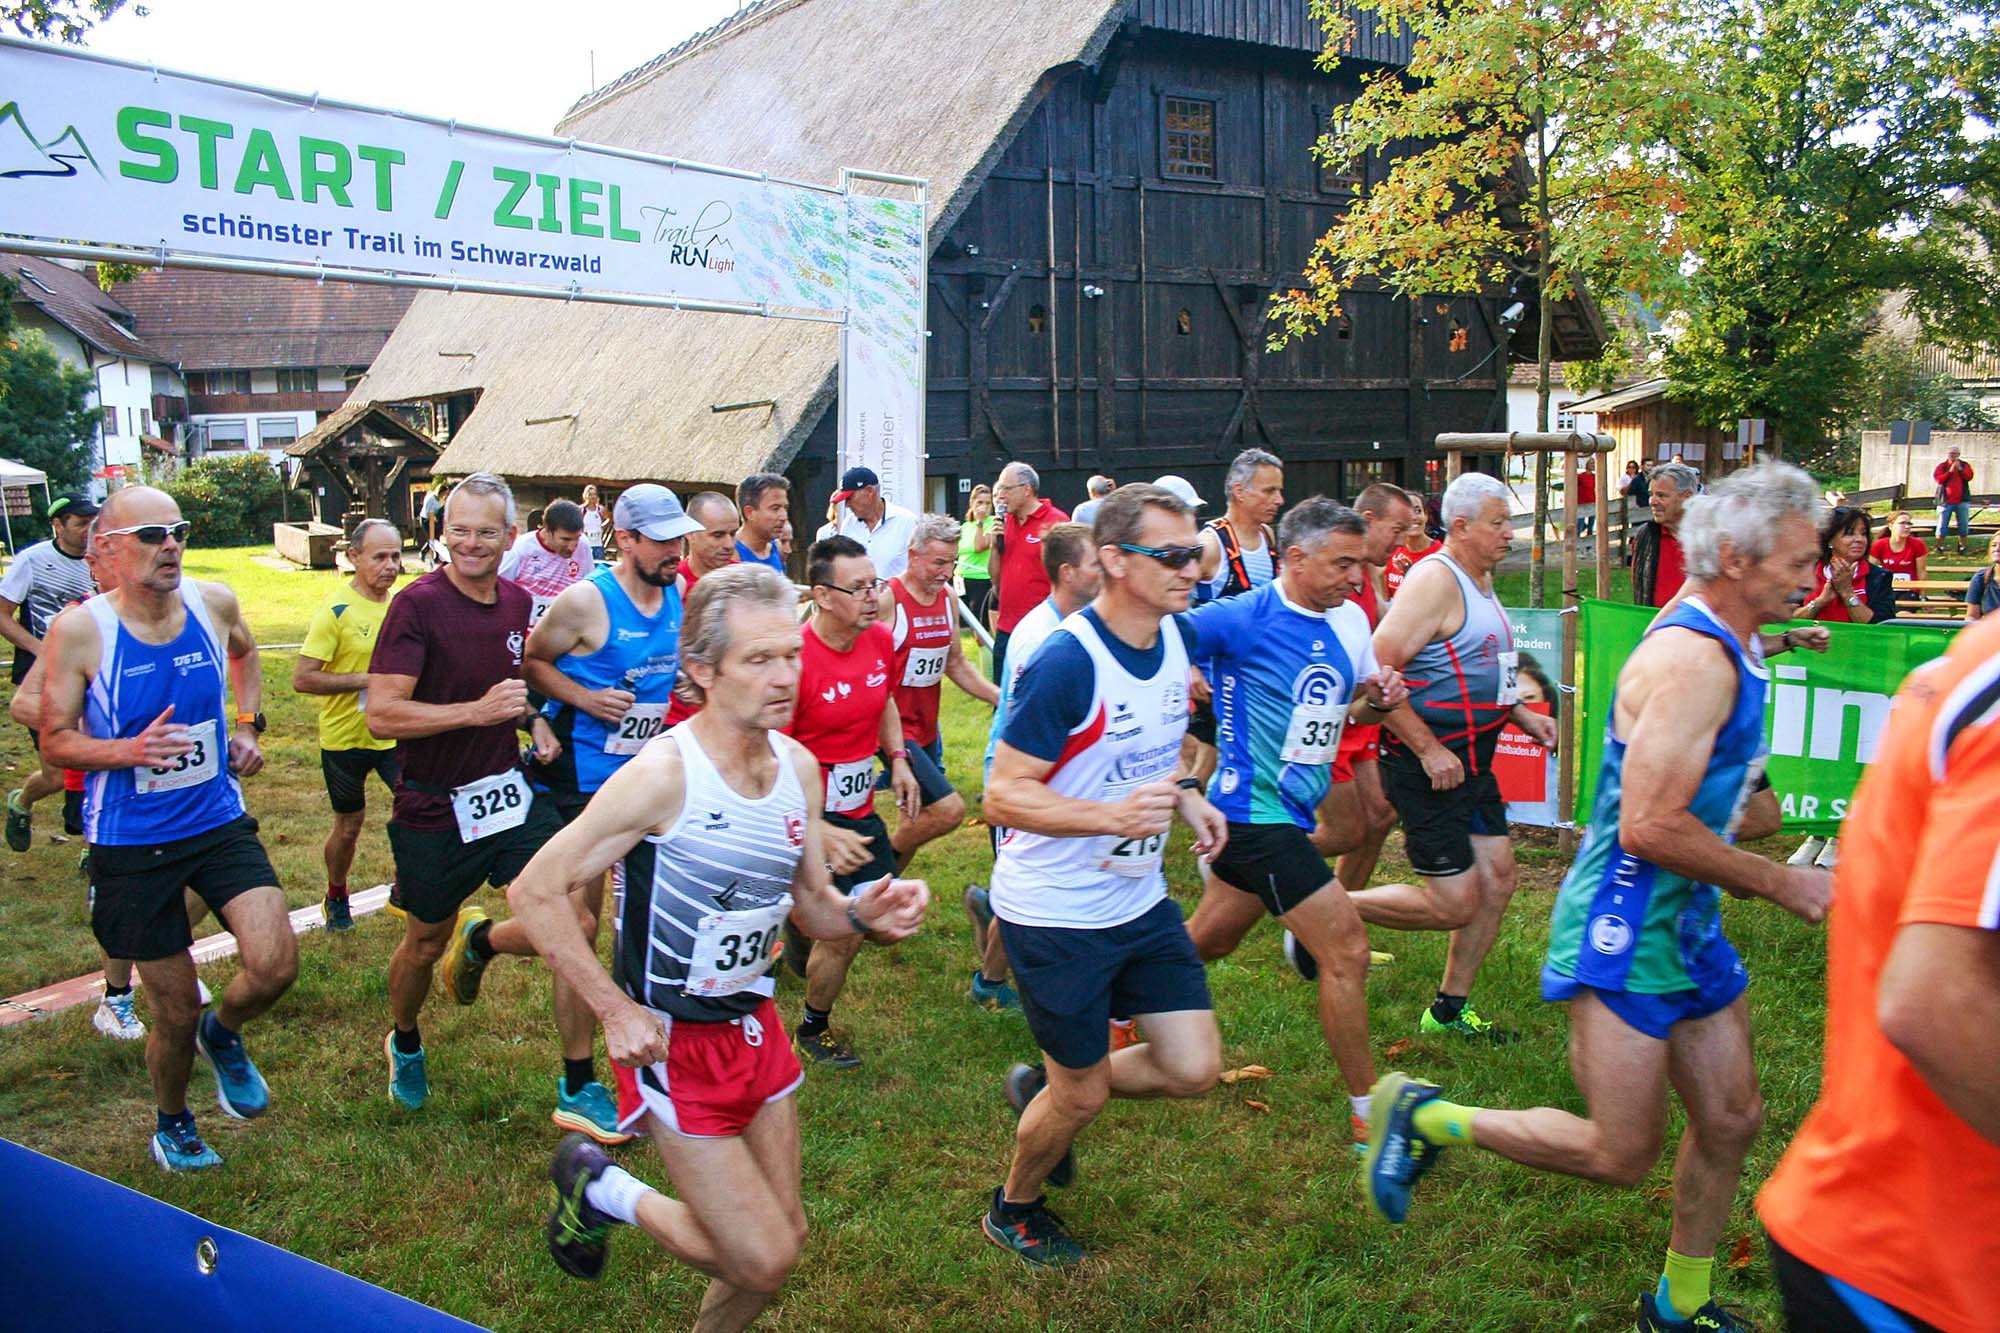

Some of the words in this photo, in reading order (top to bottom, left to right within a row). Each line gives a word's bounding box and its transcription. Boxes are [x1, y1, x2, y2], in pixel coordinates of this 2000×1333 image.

[117, 106, 406, 212] START
[434, 160, 465, 219] /
[493, 166, 641, 242] ZIEL
[640, 200, 732, 245] Trail
[183, 213, 333, 247] schönster
[343, 228, 404, 255] Trail
[414, 235, 442, 258] im
[450, 240, 601, 274] Schwarzwald
[670, 244, 709, 268] RUN
[708, 257, 735, 273] Light
[915, 657, 943, 676] 319
[621, 716, 663, 740] 202
[1302, 721, 1341, 747] 331
[841, 769, 873, 798] 303
[468, 783, 521, 821] 328
[1773, 792, 1819, 819] AR
[716, 924, 779, 971] 330
